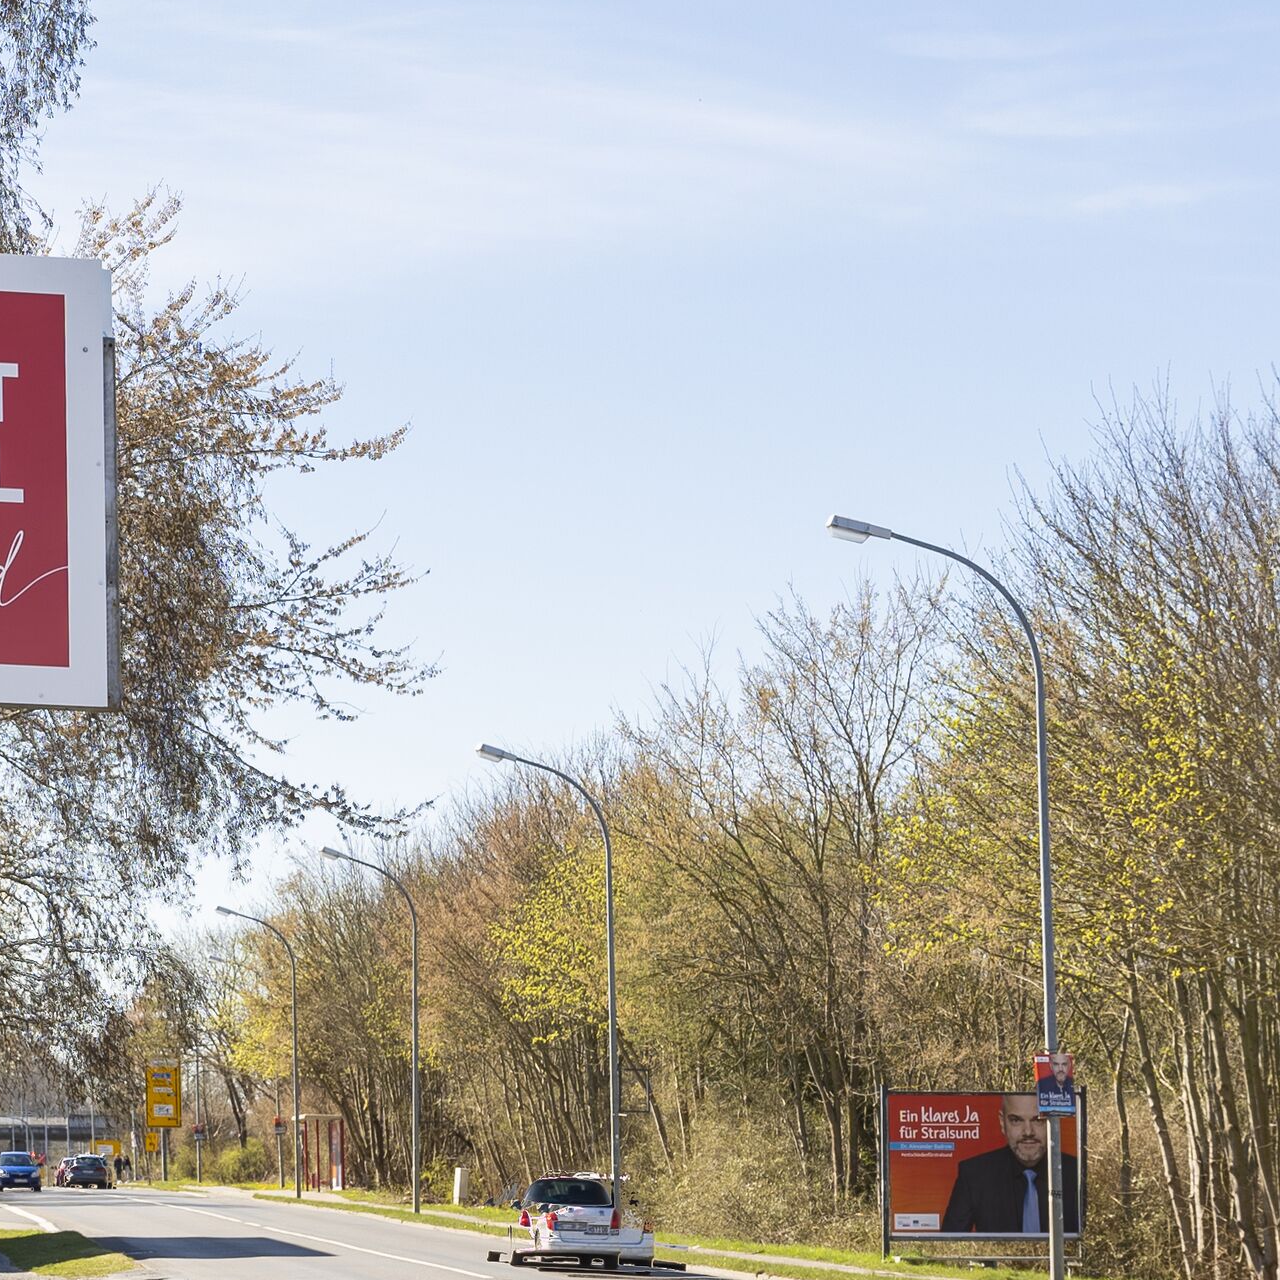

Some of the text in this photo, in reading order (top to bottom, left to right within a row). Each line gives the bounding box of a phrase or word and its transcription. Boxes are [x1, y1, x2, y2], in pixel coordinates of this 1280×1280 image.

[899, 1105, 979, 1123] Ein klares Ja
[899, 1126, 979, 1139] für Stralsund
